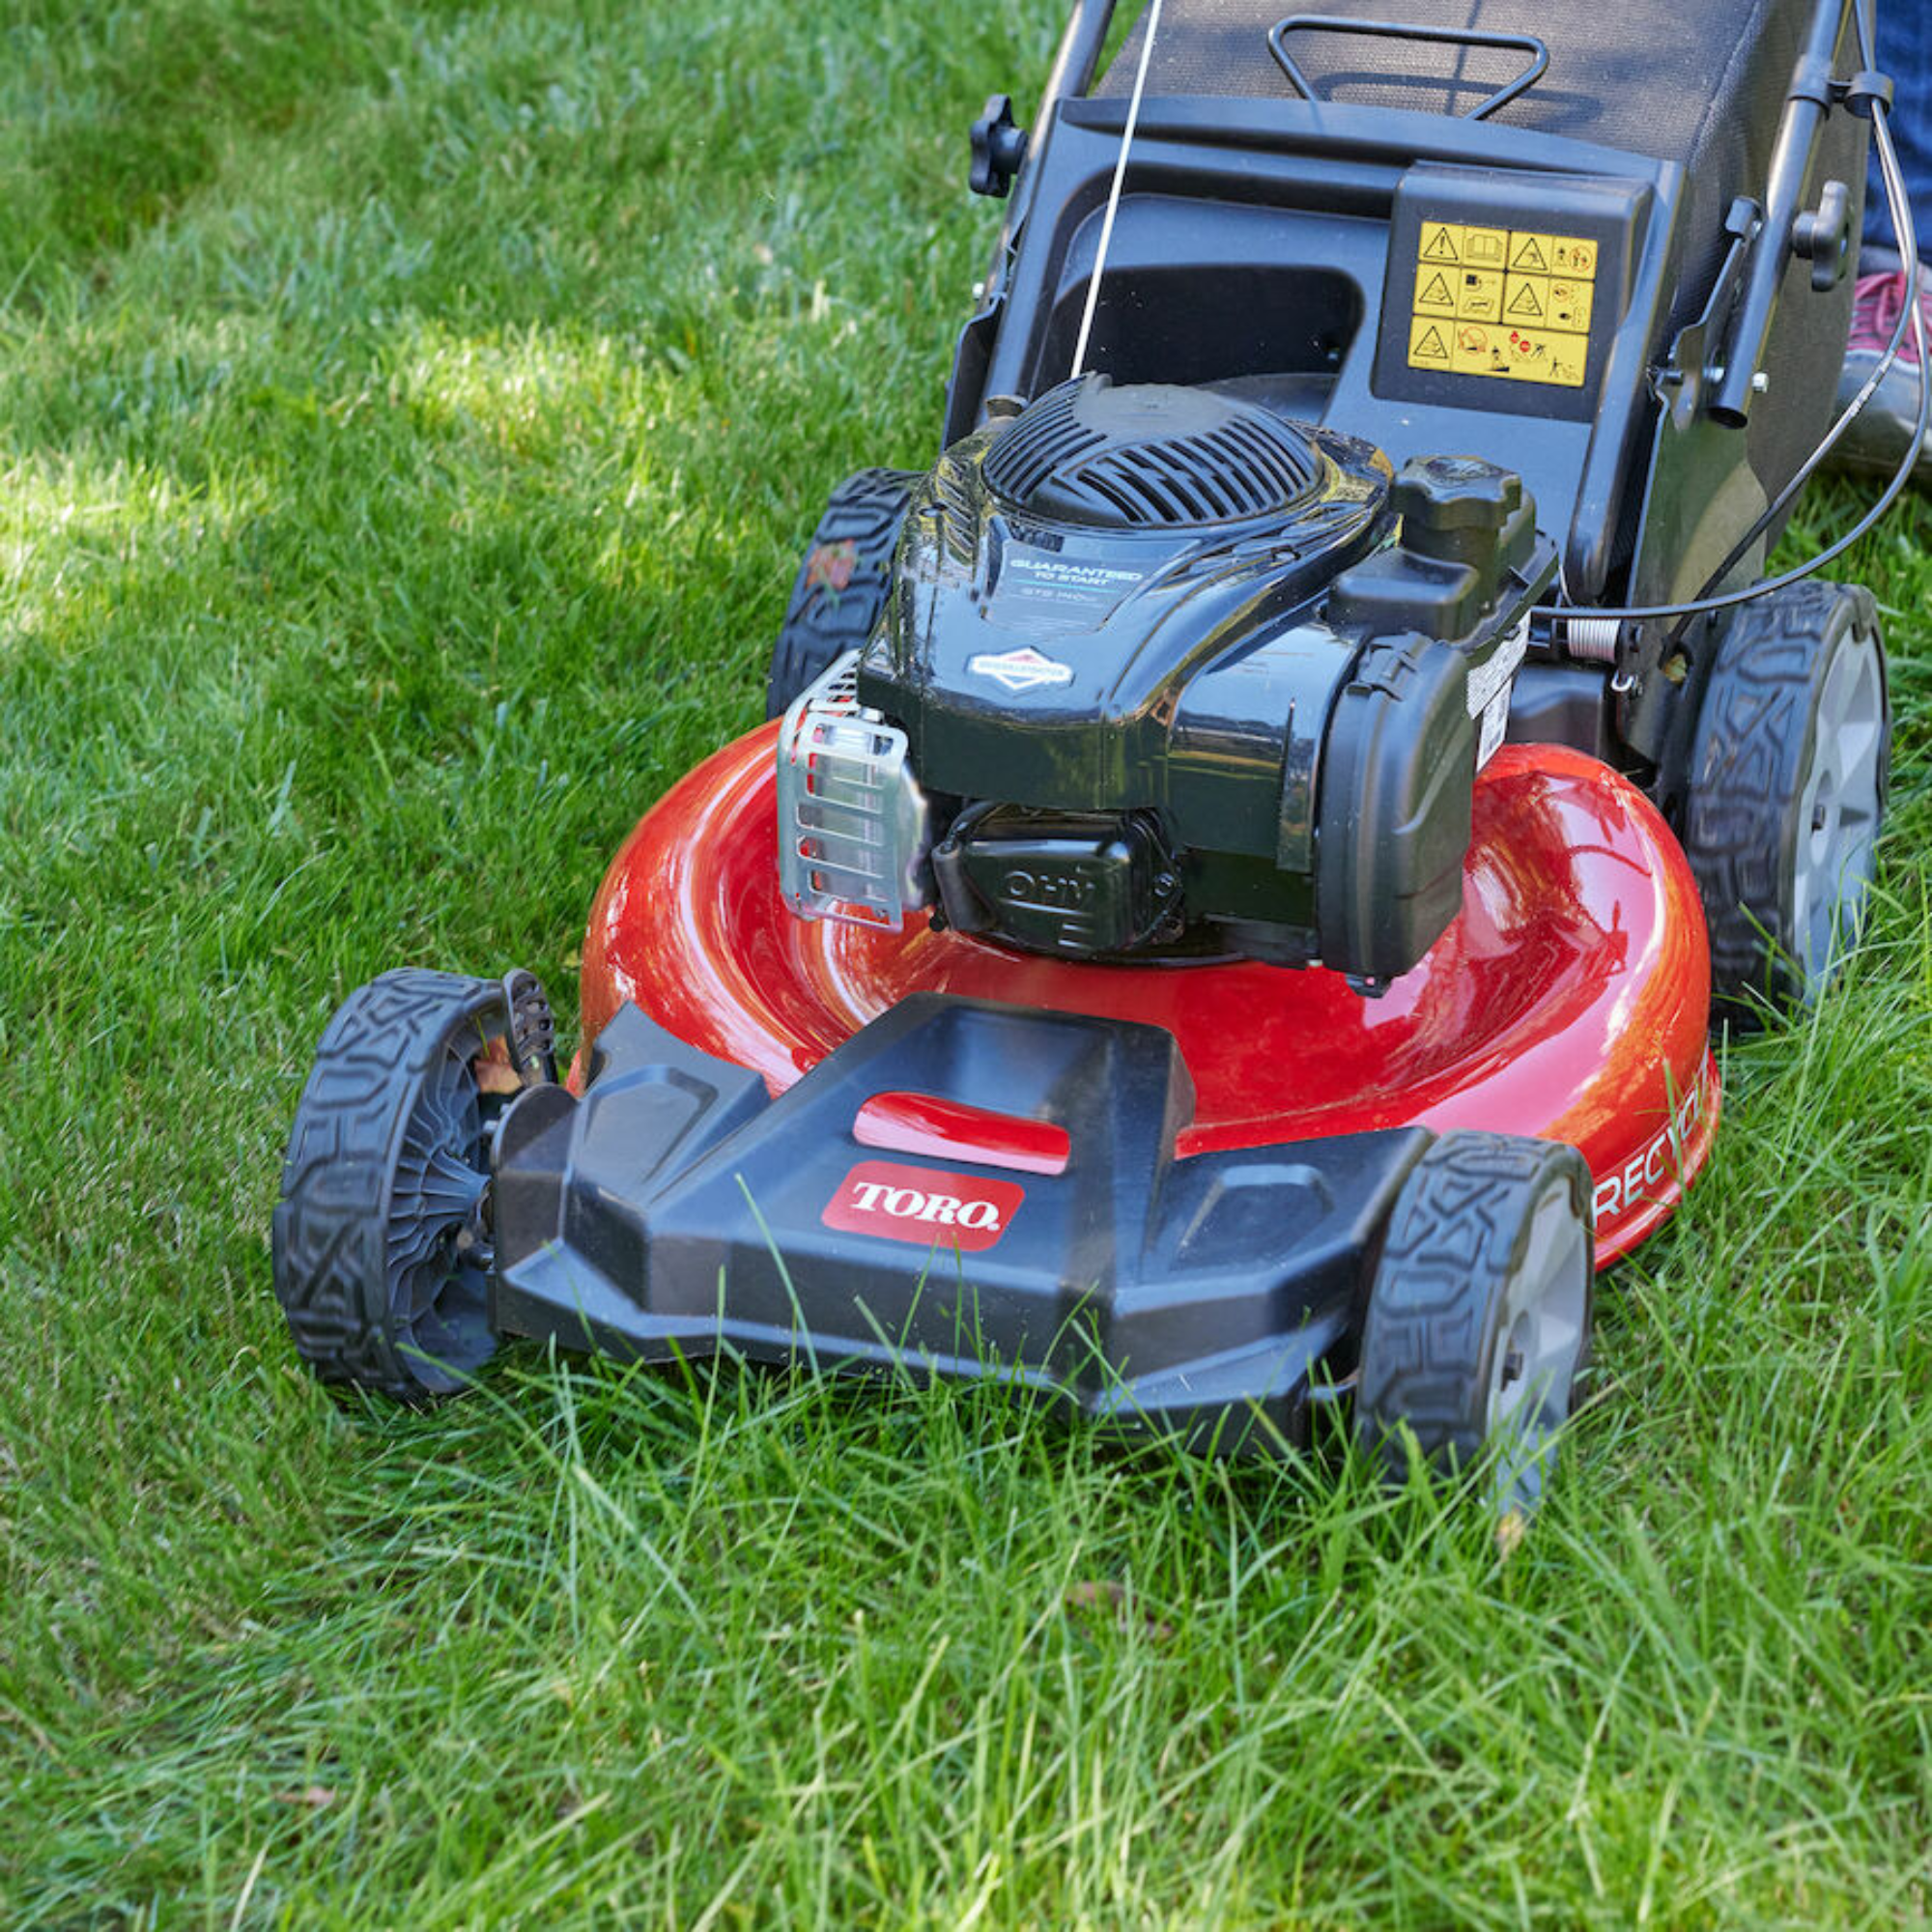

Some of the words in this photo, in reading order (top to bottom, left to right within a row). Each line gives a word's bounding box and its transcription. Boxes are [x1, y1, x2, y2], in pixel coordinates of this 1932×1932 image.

[1010, 559, 1143, 581] GUARANTEED
[1035, 571, 1051, 581] TO
[1058, 573, 1111, 585] START
